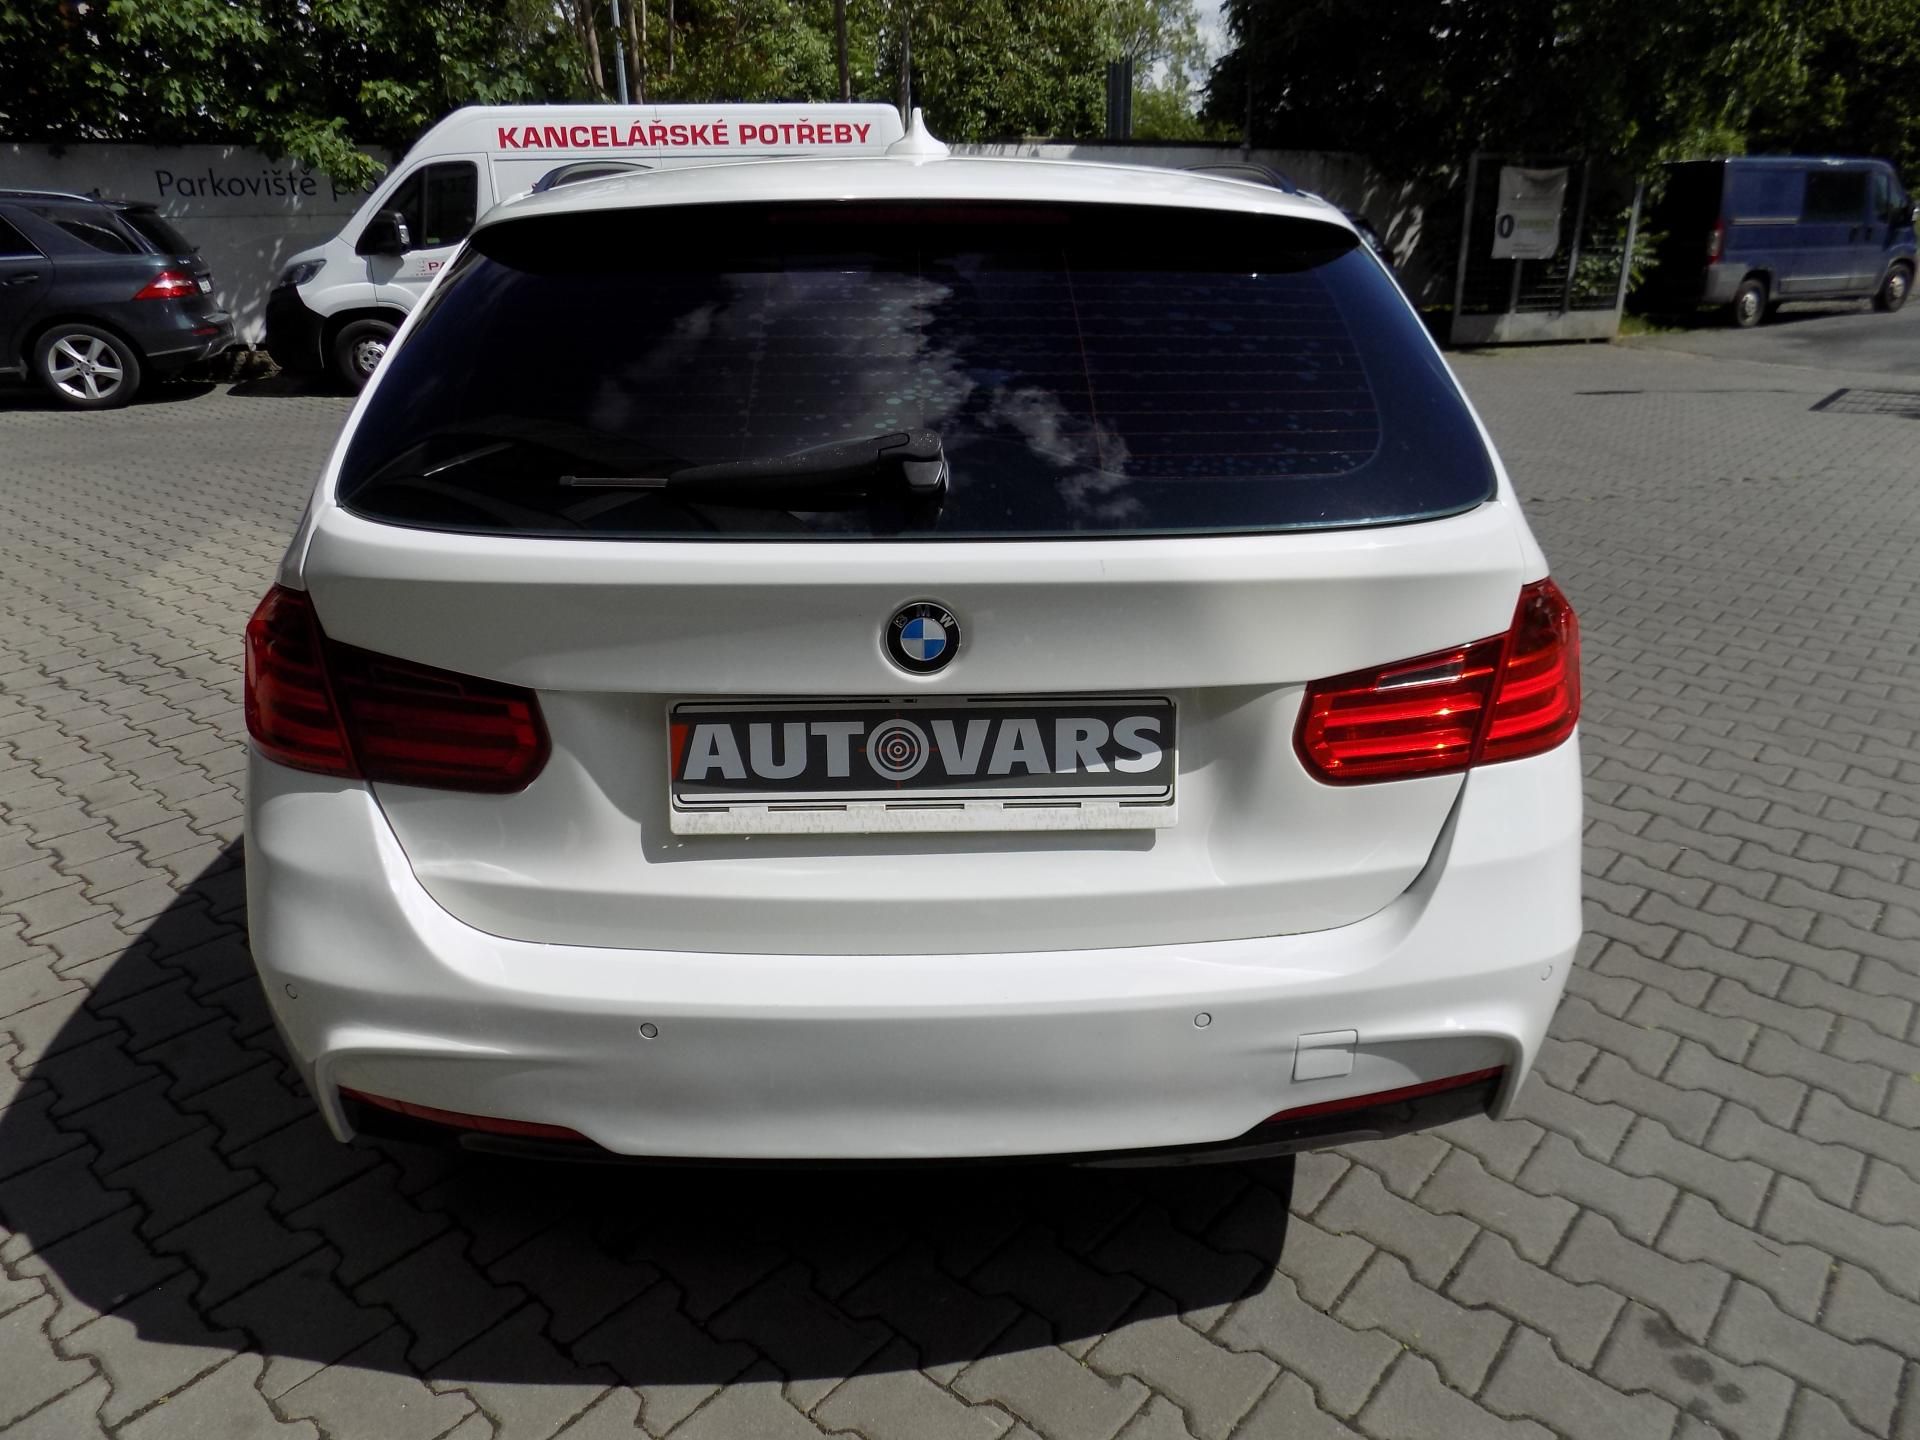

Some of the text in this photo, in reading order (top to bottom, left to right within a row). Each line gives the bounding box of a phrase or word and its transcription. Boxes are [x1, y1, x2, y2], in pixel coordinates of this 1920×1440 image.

[498, 118, 871, 149] KANCELÁŘSKÉ POTŘEBY
[156, 167, 317, 197] Parkoviště
[893, 604, 955, 629] BMW
[683, 716, 1163, 781] AUTOVARS
